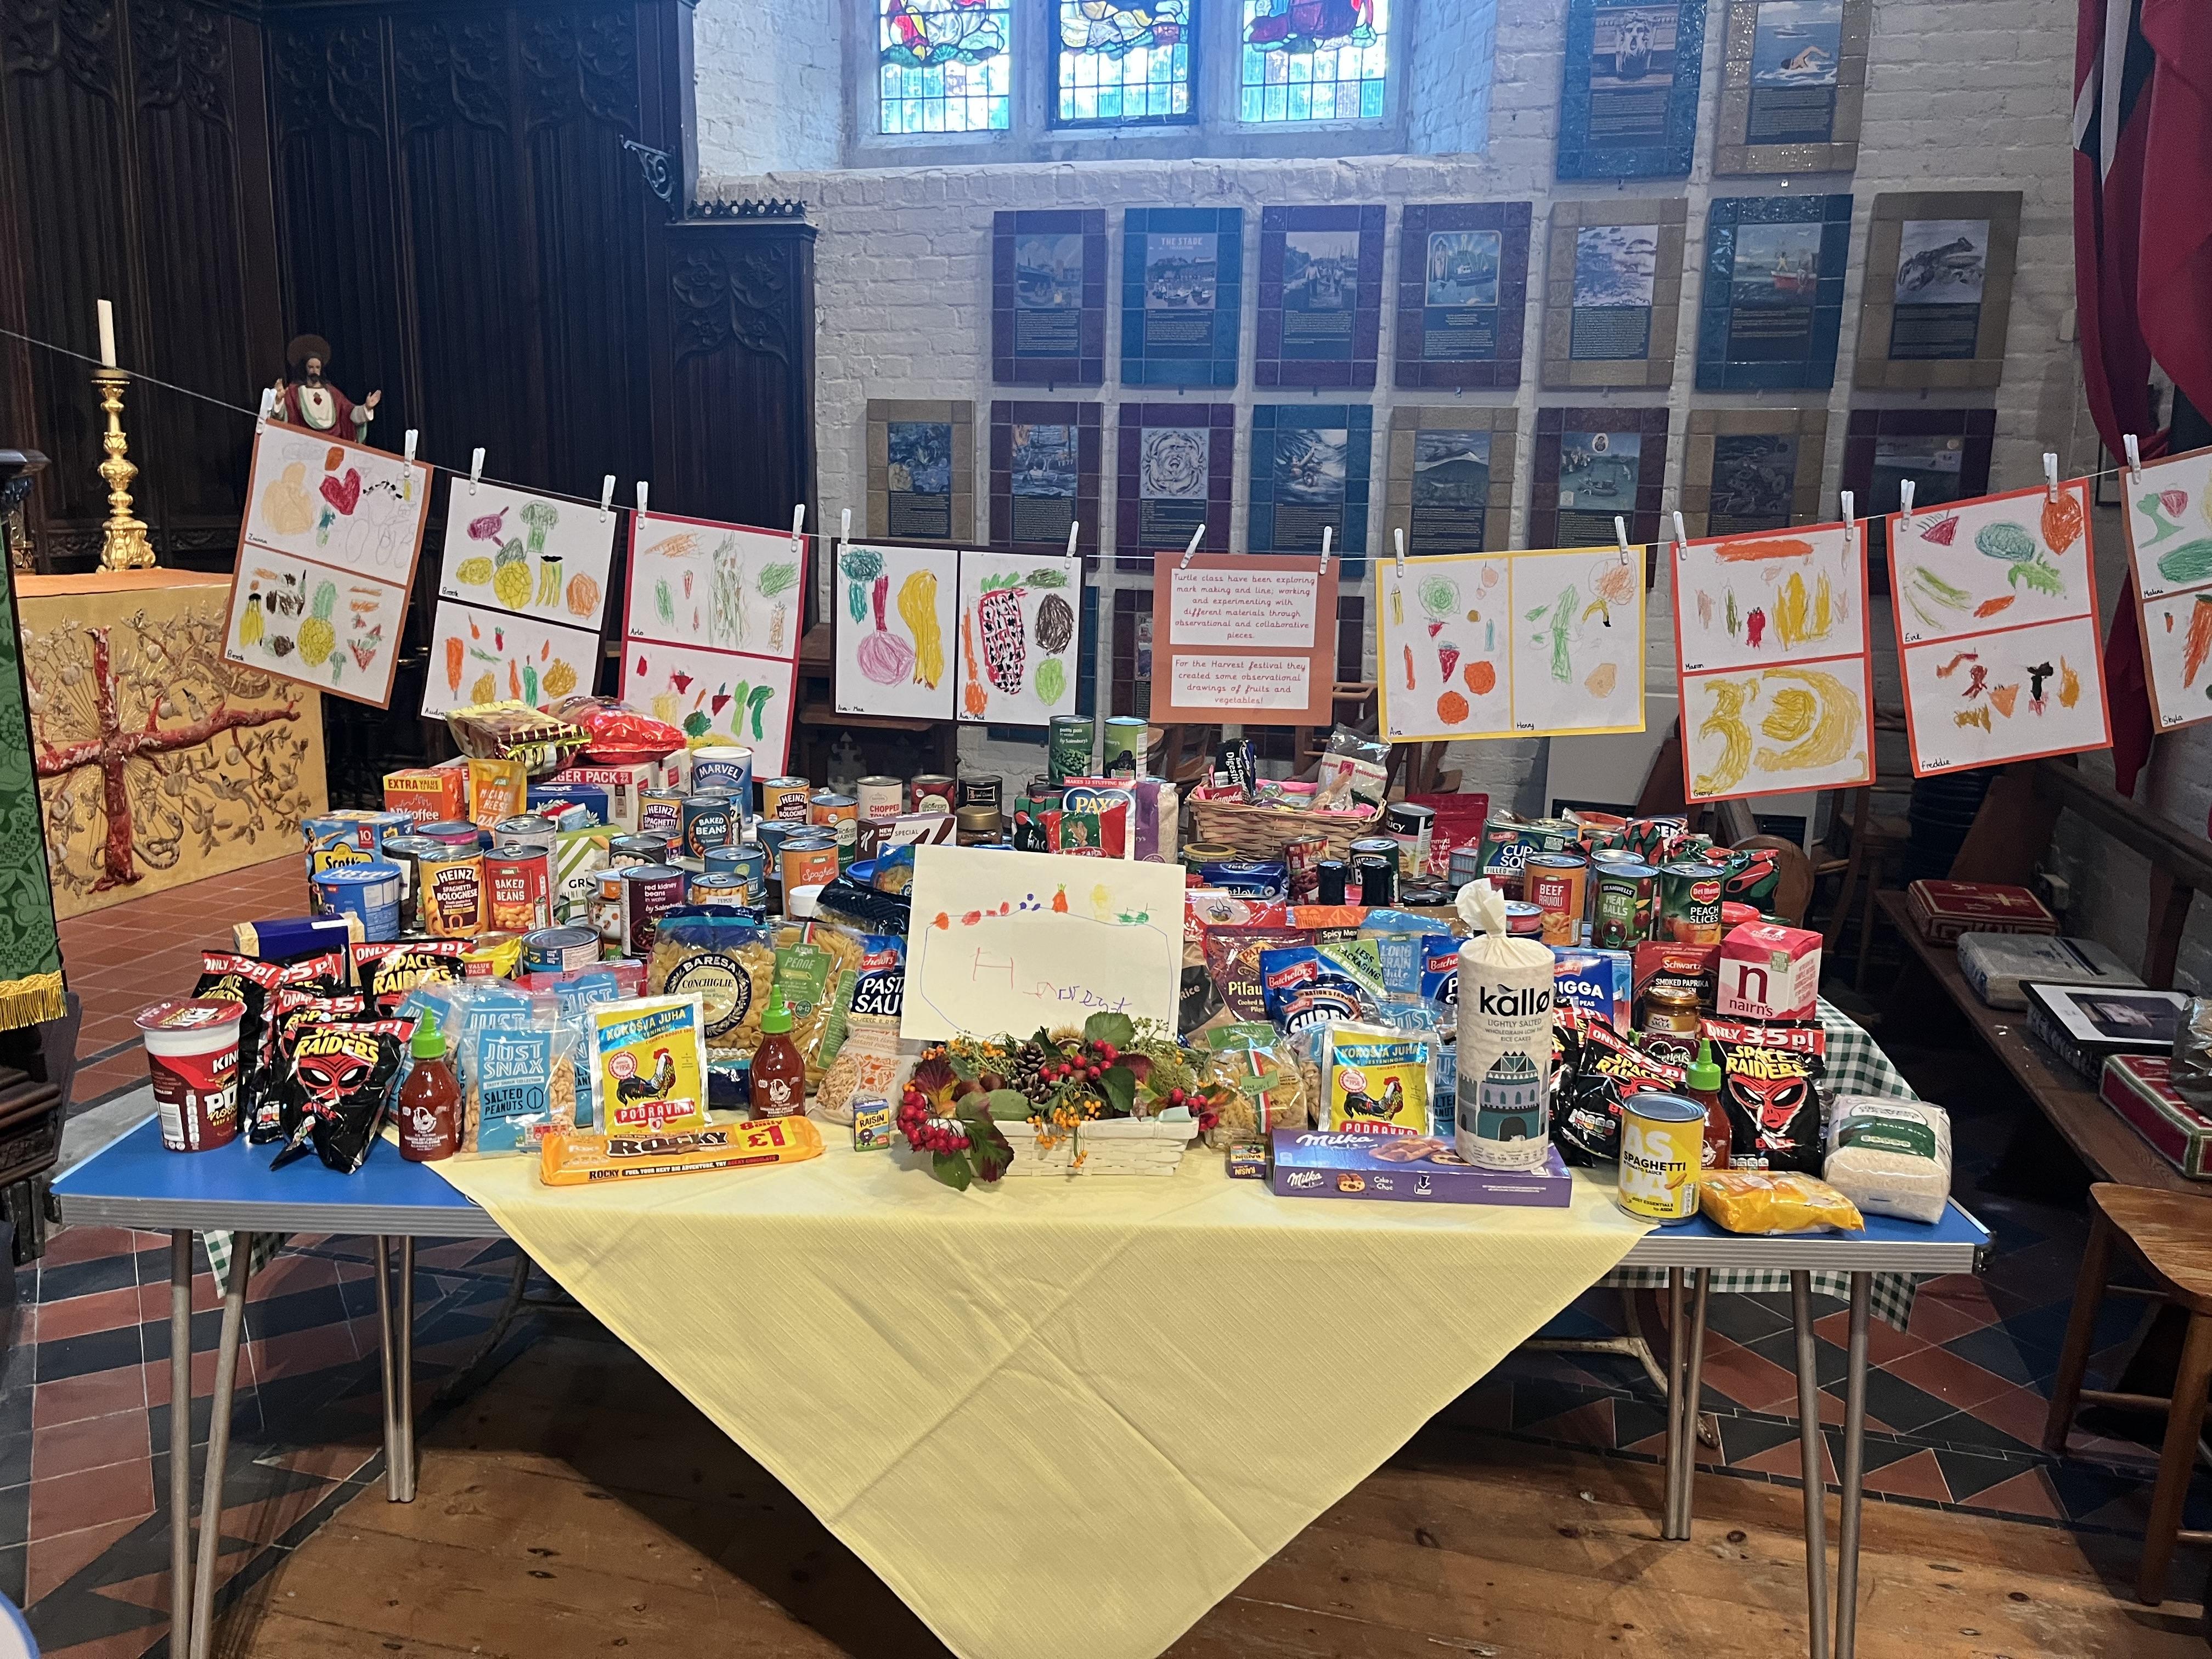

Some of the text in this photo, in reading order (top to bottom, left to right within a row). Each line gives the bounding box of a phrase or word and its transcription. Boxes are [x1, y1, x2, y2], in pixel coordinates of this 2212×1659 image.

[1179, 237, 1203, 245] STADE
[1276, 577, 1315, 585] exploring
[1201, 586, 1231, 595] making
[1269, 610, 1301, 619] through
[1248, 662, 1282, 670] festival
[1288, 663, 1305, 672] they
[1231, 685, 1240, 693] of
[1245, 685, 1269, 693] fruits
[1390, 727, 1402, 735] Ava
[1921, 759, 1951, 769] Freddie
[699, 764, 738, 778] MARVEL
[586, 771, 617, 783] PACK
[388, 779, 417, 789] EXTRA
[781, 793, 804, 803] HEINZ
[647, 805, 674, 815] HEINZ
[870, 804, 900, 812] CHOPPED
[644, 817, 676, 826] SPAGHETTI
[699, 817, 724, 827] BAKED
[360, 830, 372, 840] 10
[696, 824, 726, 835] BEANS
[438, 869, 472, 882] HEINZ
[442, 884, 471, 892] SPAGHETTI
[495, 878, 524, 889] BAKED
[658, 882, 676, 891] kidney
[437, 889, 478, 901] BOLOGNESE
[1539, 884, 1564, 895] BEEF
[496, 891, 525, 901] BEANS
[1539, 895, 1563, 906] RAVIOLI
[1605, 894, 1626, 906] MEAT
[1602, 905, 1629, 916] BALLS
[1690, 906, 1719, 916] PEACH
[1690, 913, 1718, 924] SLICES
[1323, 930, 1341, 938] Spicy
[1355, 946, 1375, 963] LESS
[1381, 946, 1412, 957] LONG
[683, 956, 736, 974] BARESA
[1338, 946, 1381, 980] PACKAGING
[1663, 961, 1701, 970] Schwartz
[681, 979, 734, 989] CONCHIGLIE
[1228, 981, 1262, 996] Pilau
[1655, 978, 1709, 988] SMOKED PAPRIKA
[1737, 964, 1768, 1005] n
[1180, 985, 1200, 1000] Rice
[1555, 981, 1604, 1000] IGGA
[1729, 999, 1773, 1017] nairn's
[659, 1009, 686, 1024] JUHA
[1488, 1018, 1542, 1028] LIGHTLY SALTED
[1485, 1028, 1523, 1036] WHOLEGRAIN
[1707, 1025, 1739, 1041] ONLY
[295, 1035, 379, 1060] RAIDERS
[485, 1041, 544, 1062] JUST
[1392, 1045, 1419, 1056] JUHA
[483, 1057, 544, 1080] SNAX
[1726, 1057, 1813, 1080] RAIDERS
[483, 1088, 522, 1105] SALTED
[483, 1100, 523, 1115] PEANUTS
[860, 1114, 884, 1128] RAISIN
[748, 1126, 786, 1149] £1
[1296, 1134, 1374, 1147] Milka
[607, 1132, 729, 1156] ROCKY
[1624, 1150, 1686, 1171] SPAGHETTI
[589, 1170, 619, 1180] ROCKY
[1287, 1172, 1323, 1187] Milka
[1643, 1198, 1673, 1206] ESSENTIALS
